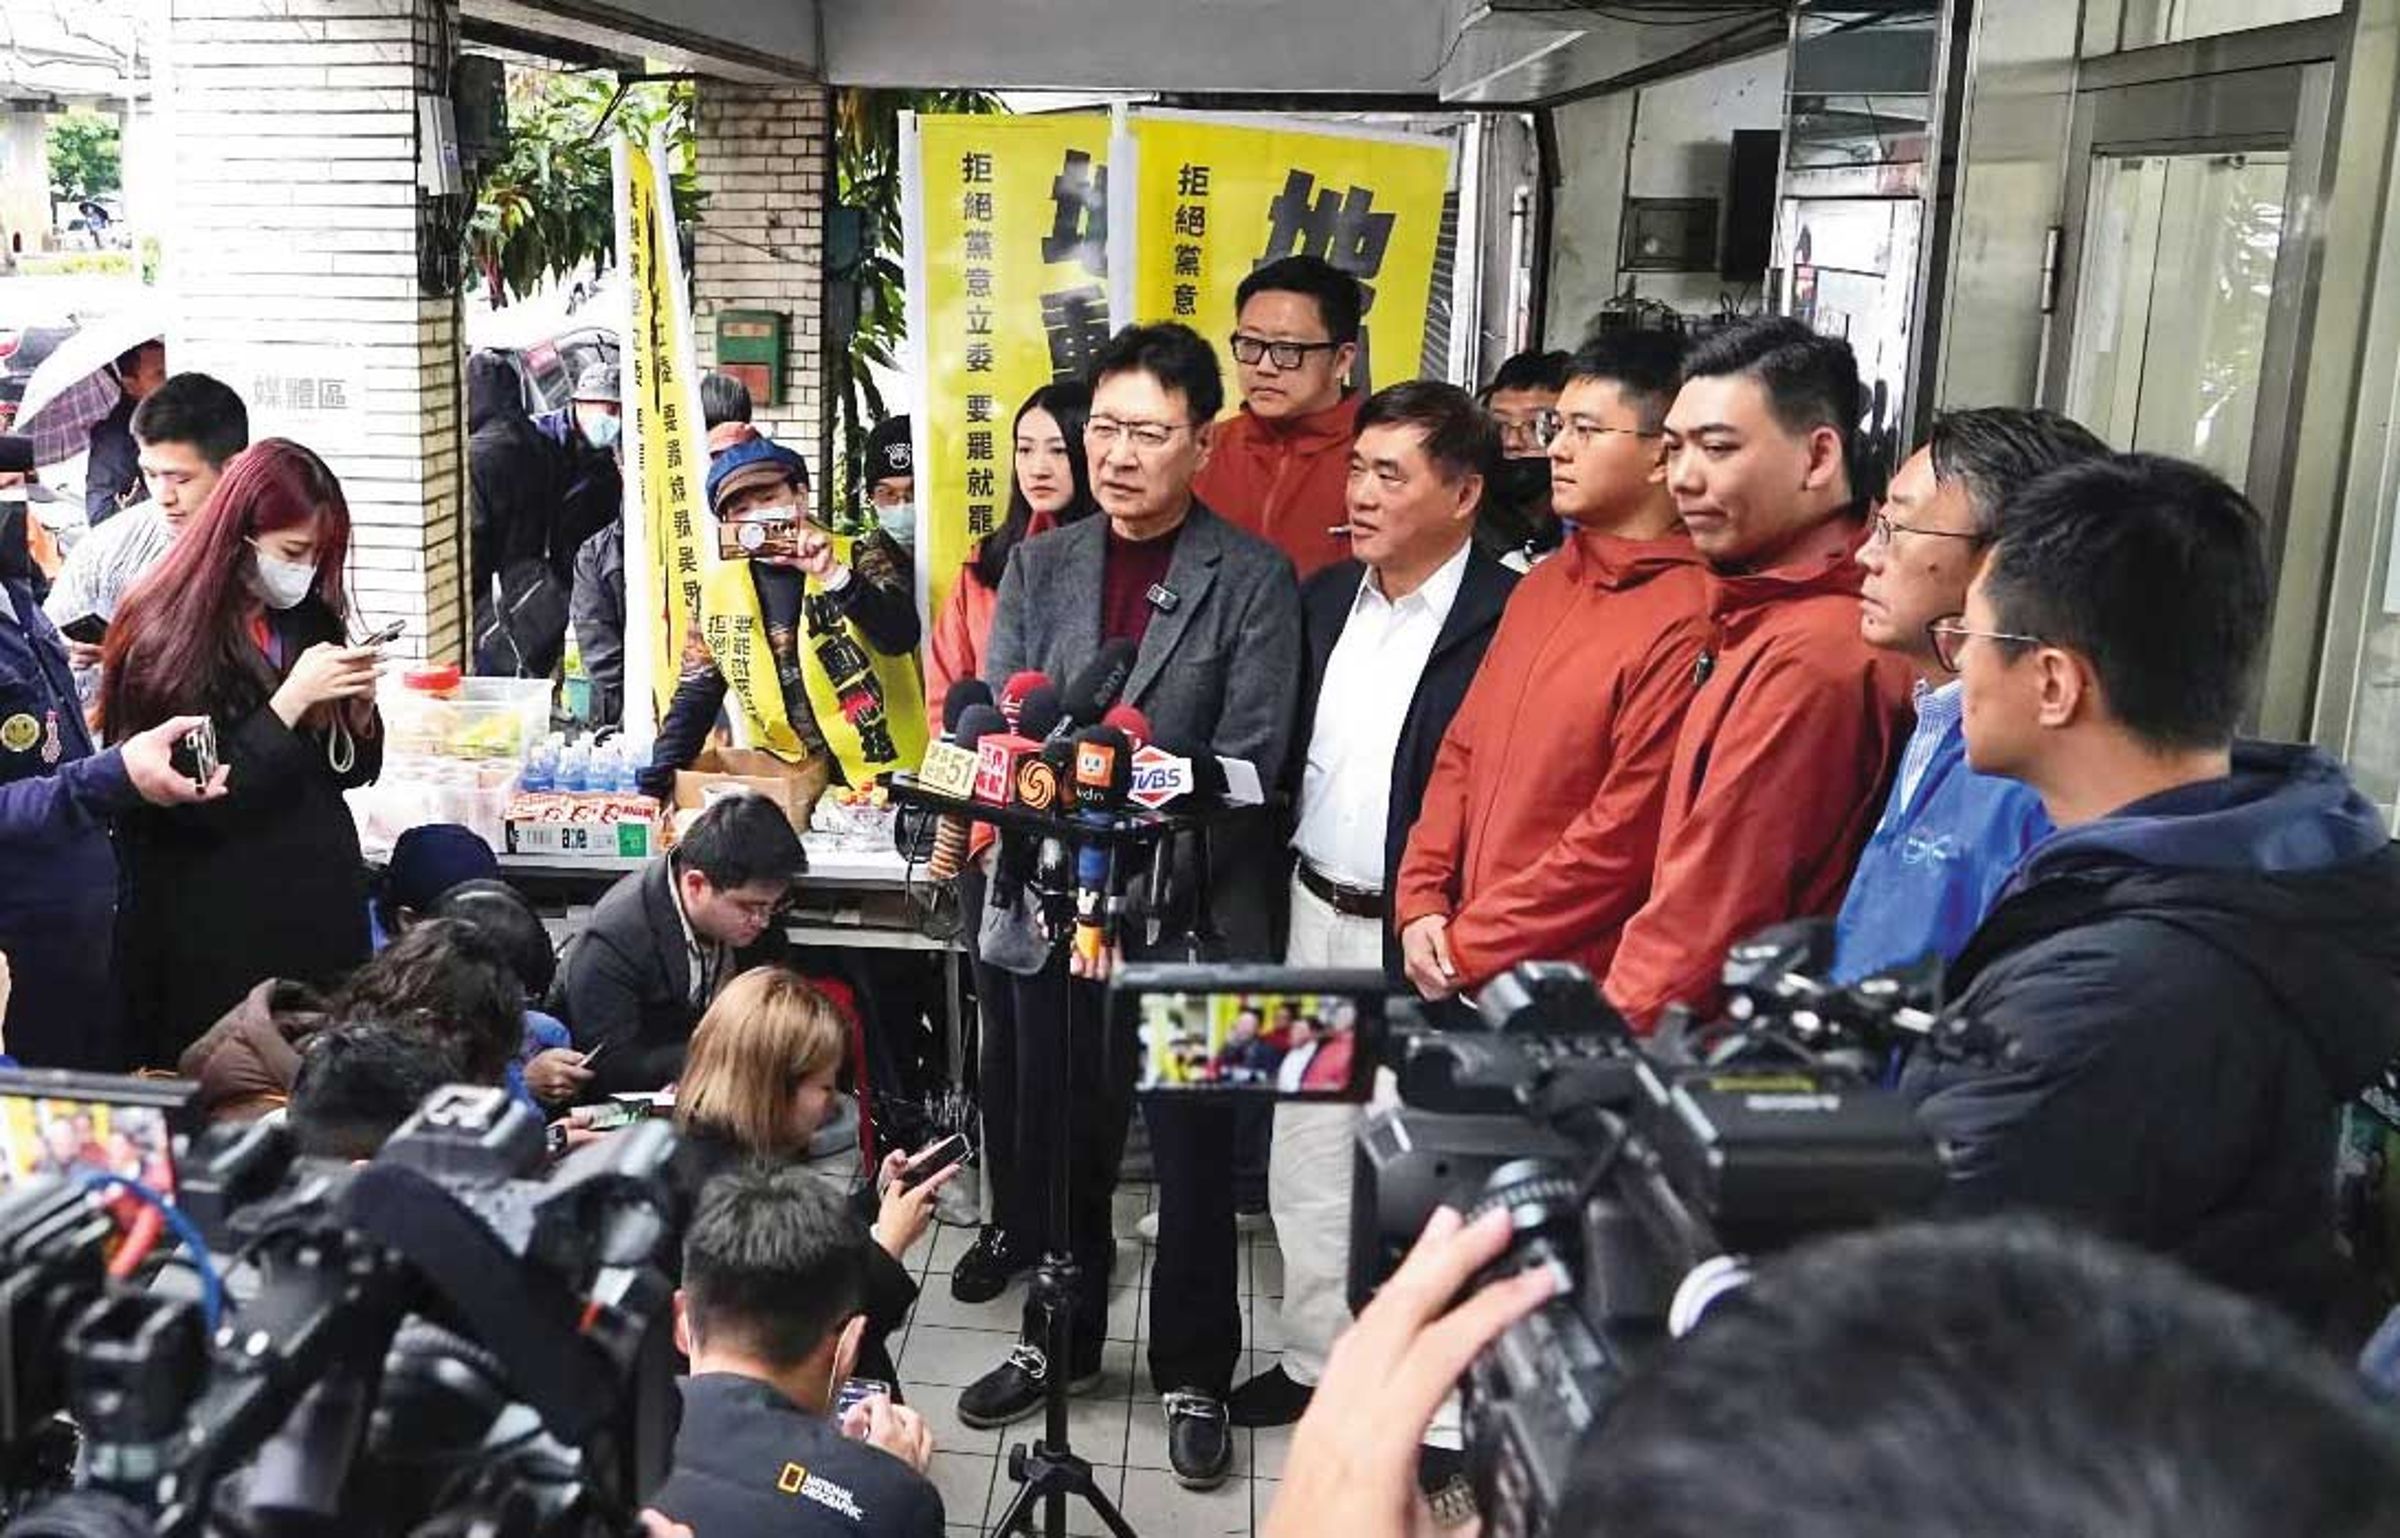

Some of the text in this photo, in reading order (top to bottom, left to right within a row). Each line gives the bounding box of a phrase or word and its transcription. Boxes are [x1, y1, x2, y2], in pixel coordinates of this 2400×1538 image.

[1172, 163, 1211, 316] 拒絕黨意
[961, 151, 995, 534] 拒絕黨意立委 要罷就罷
[253, 376, 349, 410] 媒體區
[1131, 766, 1181, 790] TVBS
[800, 1484, 863, 1522] GEOGRAPHIC
[803, 1472, 853, 1500] NATIONAL
